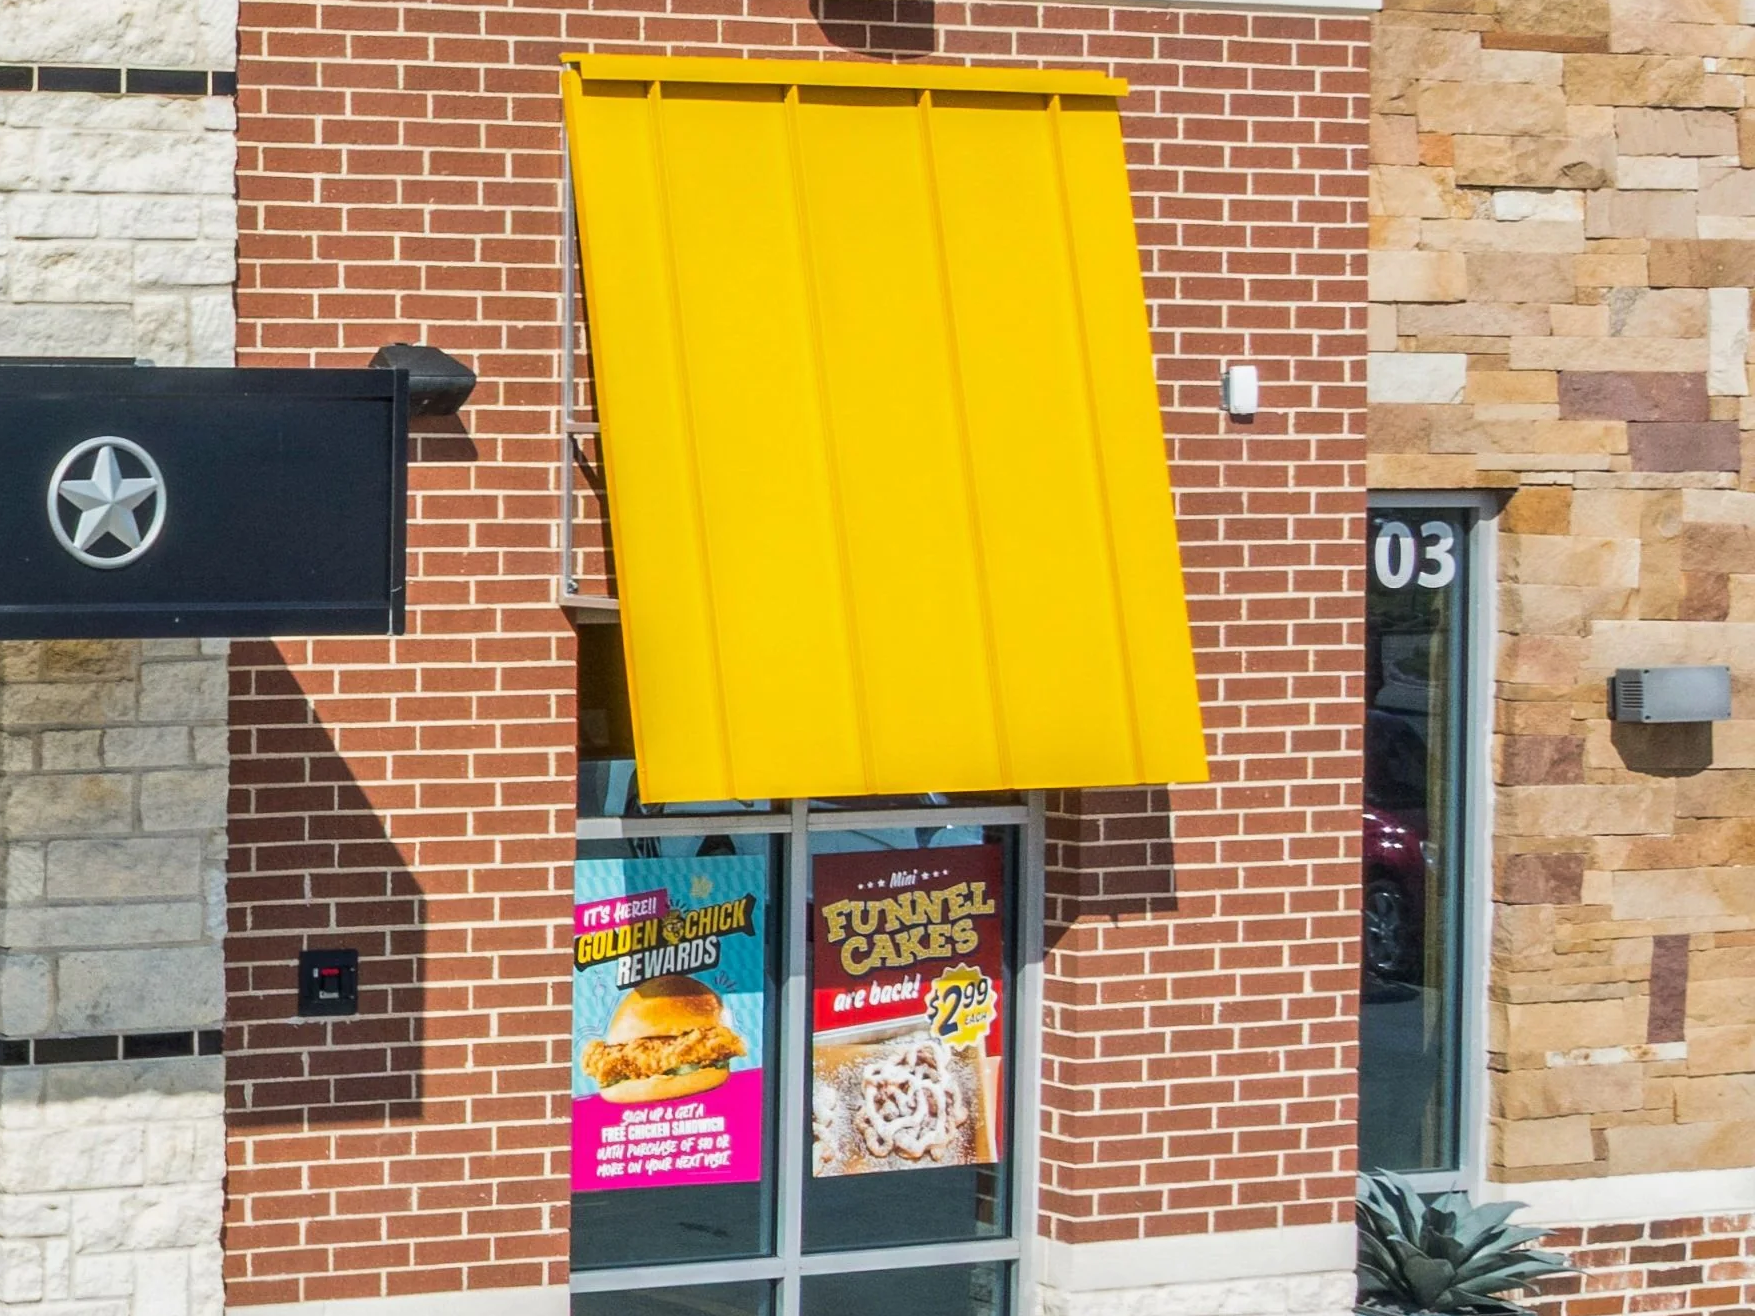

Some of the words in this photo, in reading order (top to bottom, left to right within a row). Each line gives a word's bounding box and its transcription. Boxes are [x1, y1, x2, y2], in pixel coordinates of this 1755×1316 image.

[890, 869, 918, 888] Mini
[584, 904, 611, 927] IT'S
[822, 882, 995, 943] FUNNEL
[577, 918, 658, 964] GOLDEN
[684, 899, 748, 940] CHICK
[841, 918, 979, 975] CAKES
[617, 936, 718, 986] REWARDS
[833, 989, 867, 1012] are
[869, 973, 922, 1005] back!
[964, 1012, 988, 1026] EACH
[649, 1107, 663, 1121] UP
[675, 1103, 697, 1119] GET
[601, 1126, 626, 1143] FREE
[628, 1122, 670, 1140] CHICKEN
[672, 1116, 724, 1136] SANDWICH
[627, 1140, 678, 1158] PURCHASE
[680, 1137, 695, 1152] OF
[596, 1163, 625, 1178] MORE
[628, 1160, 642, 1174] ON
[675, 1153, 704, 1169] NEXT
